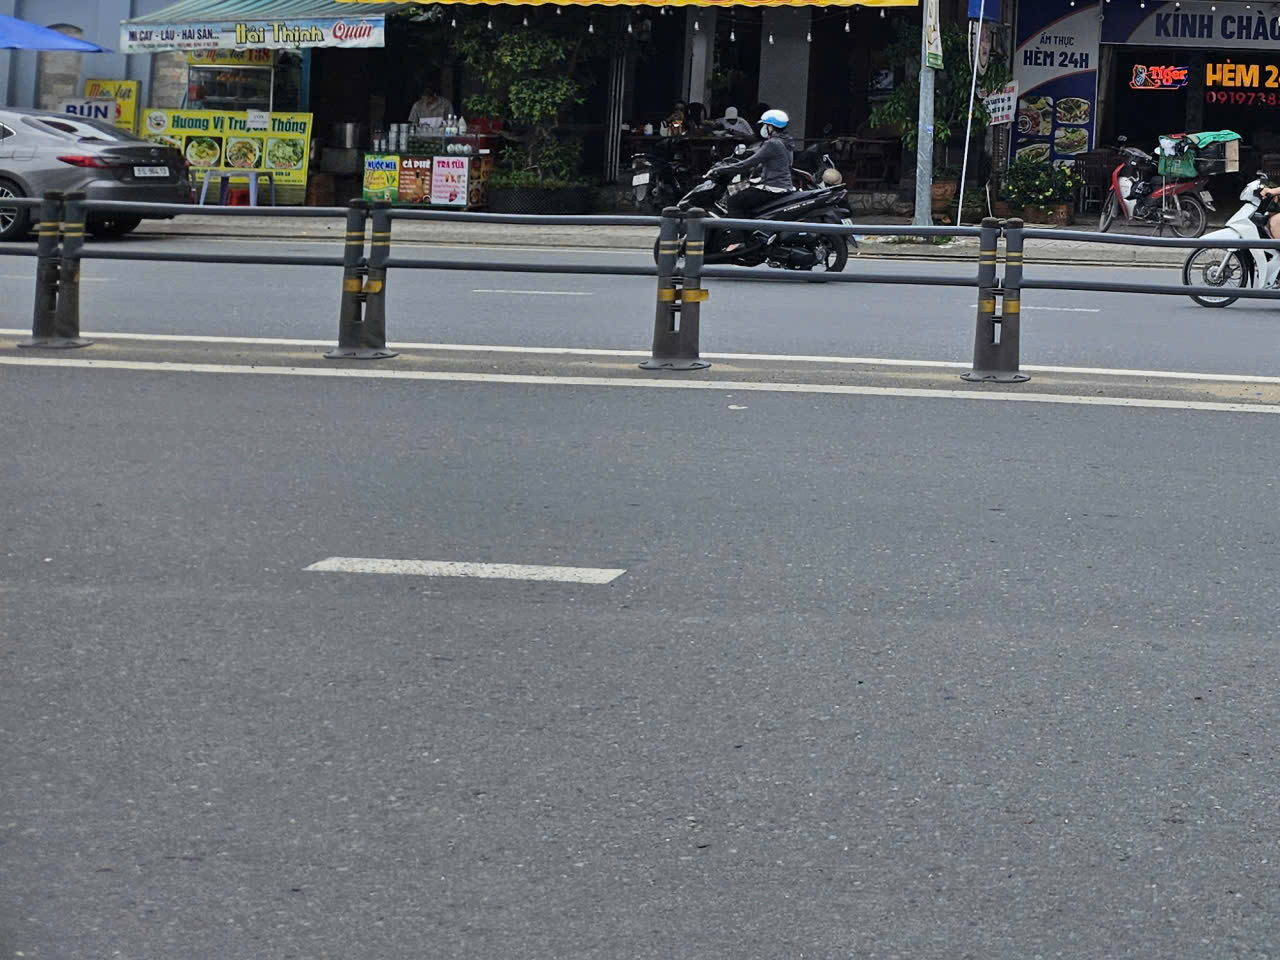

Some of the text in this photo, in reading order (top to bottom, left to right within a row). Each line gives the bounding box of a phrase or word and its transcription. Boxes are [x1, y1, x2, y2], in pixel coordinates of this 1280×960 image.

[1155, 7, 1213, 38] KÍNH
[268, 21, 325, 48] Thịnh
[1023, 47, 1089, 69] HÈM 24H
[1149, 66, 1187, 86] Tiger
[65, 101, 109, 119] BÚN
[213, 116, 225, 133] Vị
